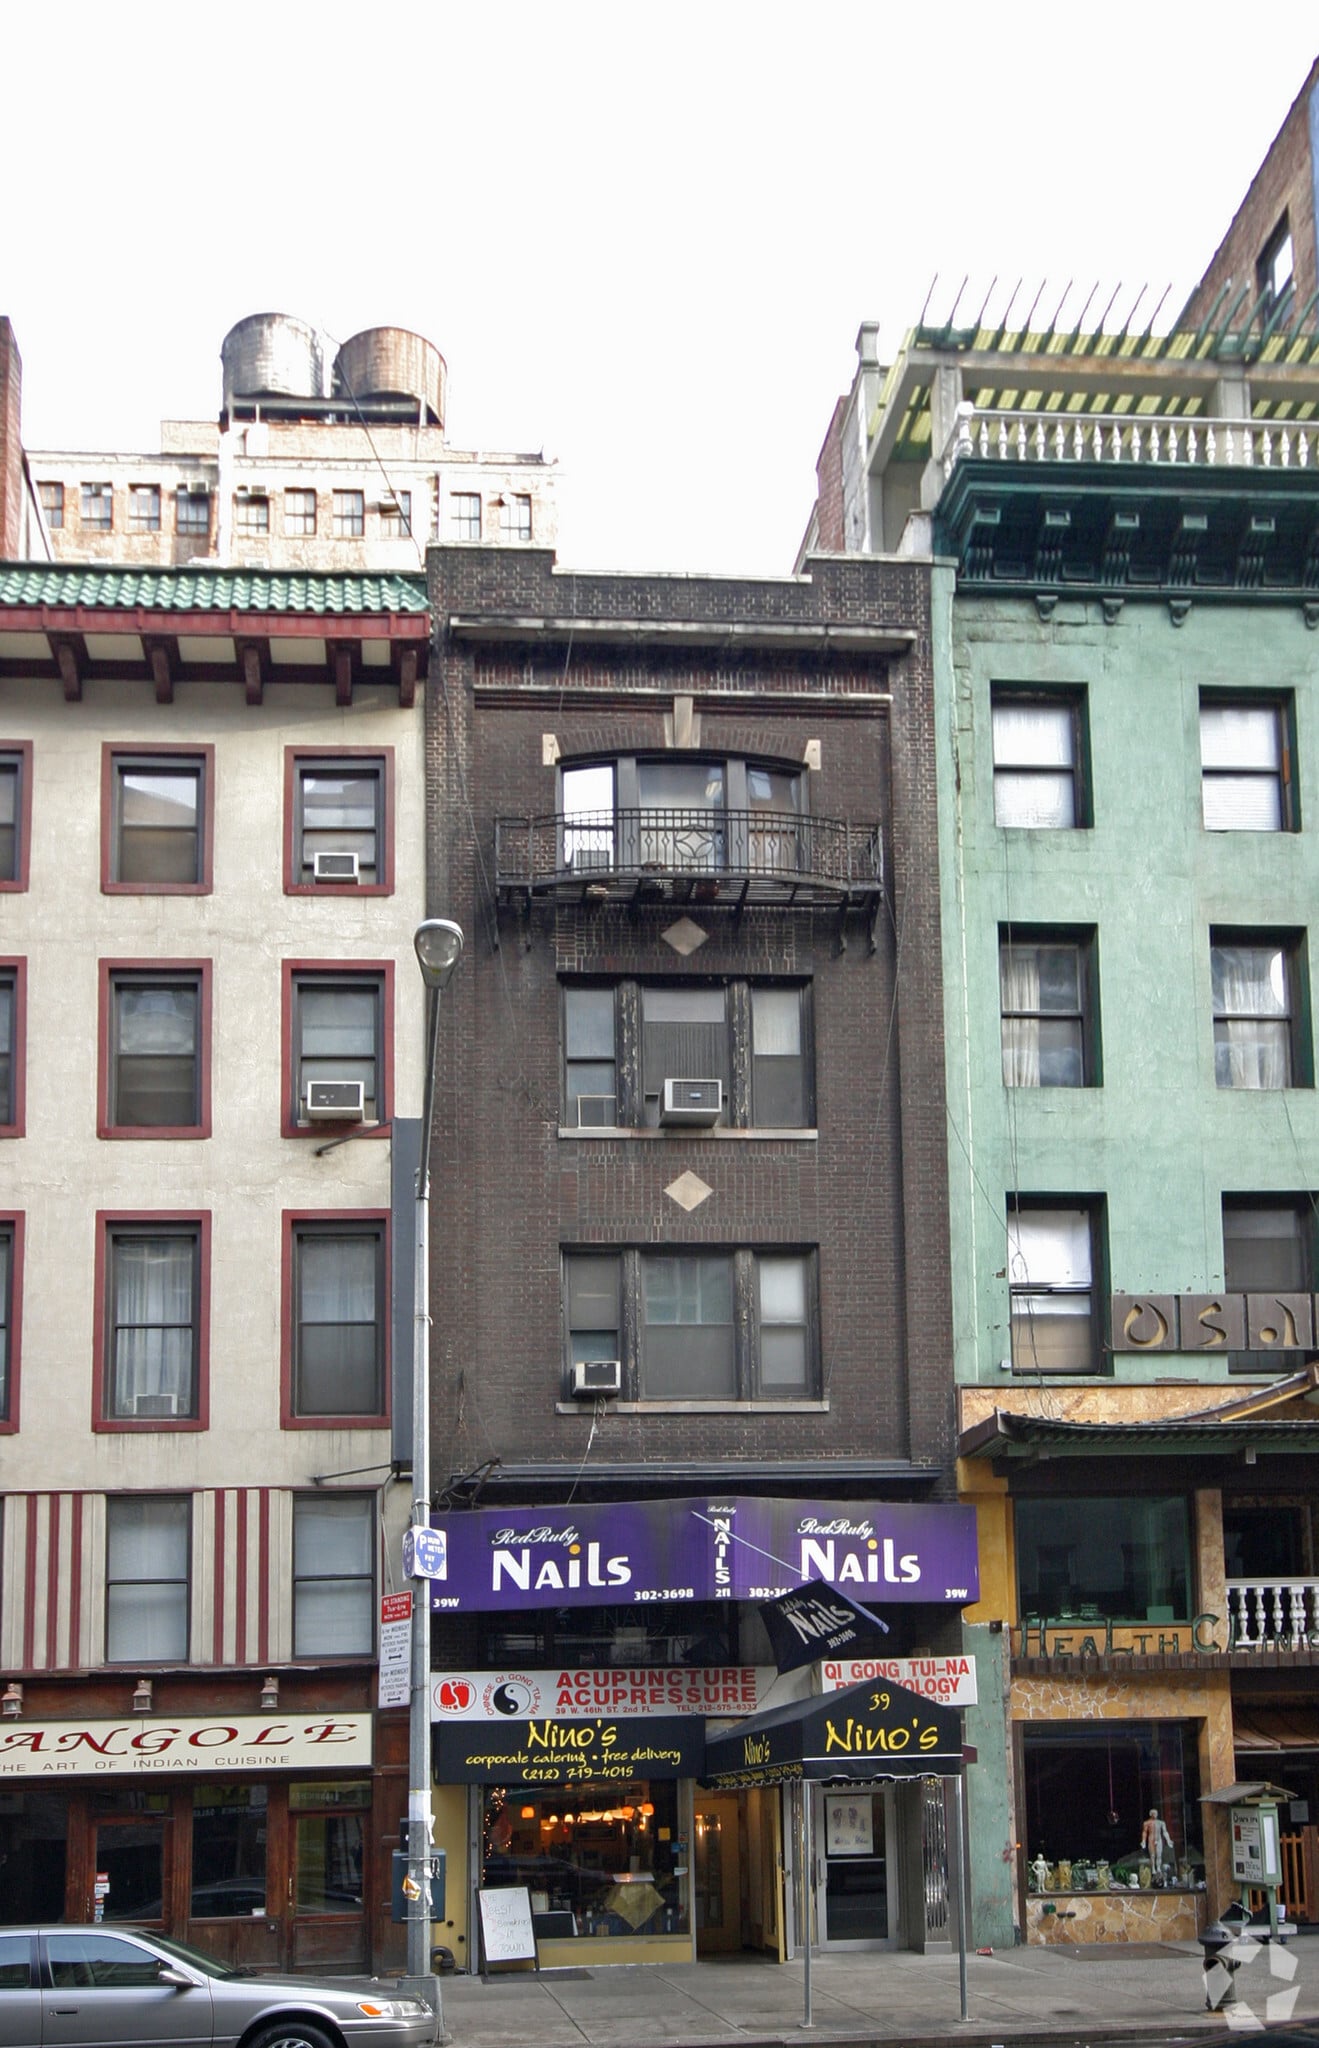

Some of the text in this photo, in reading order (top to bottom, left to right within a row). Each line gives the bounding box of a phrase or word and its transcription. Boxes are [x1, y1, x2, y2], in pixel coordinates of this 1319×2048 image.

[433, 1598, 459, 1608] 39W
[945, 1588, 968, 1599] 39W
[1020, 1616, 1179, 1658] HEALTH
[556, 1668, 757, 1689] ACUPUNCTURE
[825, 1658, 970, 1680] QI GONG TUI-NA
[556, 1686, 758, 1706] ACUPRESSURE
[867, 1692, 891, 1711] 39
[555, 1707, 566, 1715] 39
[623, 1705, 638, 1713] 2nd
[527, 1718, 618, 1748] Nino's
[825, 1718, 939, 1753] Nino's
[631, 1747, 681, 1765] delivery
[744, 1733, 770, 1766] Nino's
[0, 1755, 290, 1773] HE ART OF INDIAN CUISINE
[521, 1768, 560, 1780] (212)
